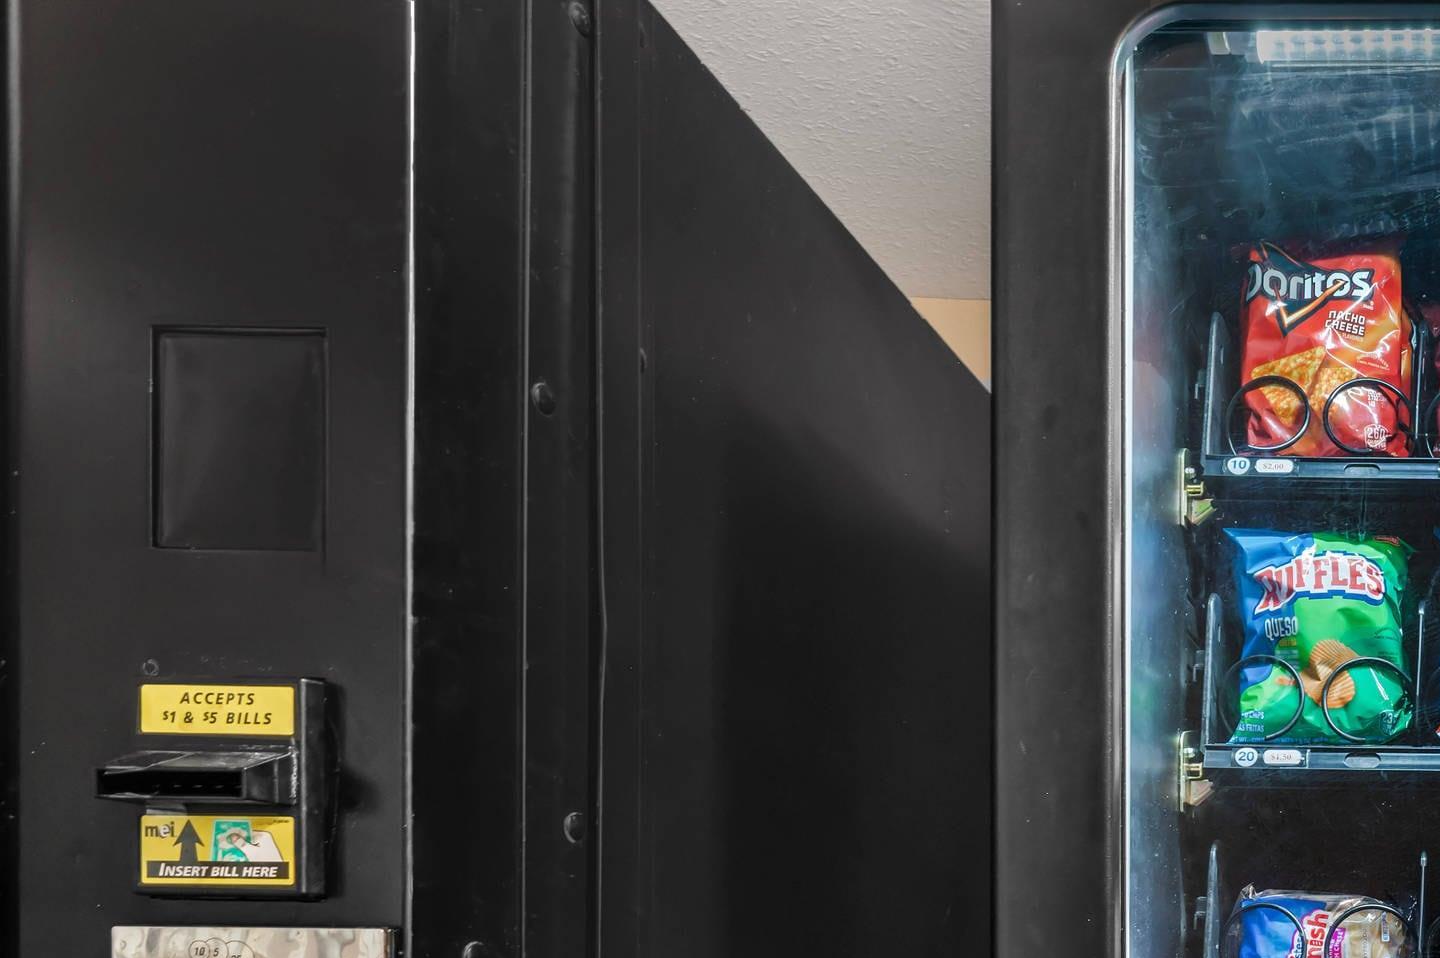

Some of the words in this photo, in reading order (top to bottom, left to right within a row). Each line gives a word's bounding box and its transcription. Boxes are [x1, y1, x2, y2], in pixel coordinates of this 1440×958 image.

[1328, 310, 1366, 325] NACHO
[1325, 319, 1365, 336] CHEESE
[1264, 616, 1298, 640] QUESO
[180, 692, 255, 705] ACCEPTS
[162, 710, 176, 723] $1
[183, 711, 194, 723] &
[203, 711, 217, 724] $5
[226, 712, 273, 725] BILLS
[1238, 751, 1255, 762] 20
[1270, 753, 1292, 761] $1.50
[145, 821, 175, 838] mei
[158, 862, 209, 877] INSERT
[211, 865, 239, 878] BILL
[242, 866, 278, 878] HERE
[194, 947, 205, 956] 10
[213, 947, 219, 957] 5
